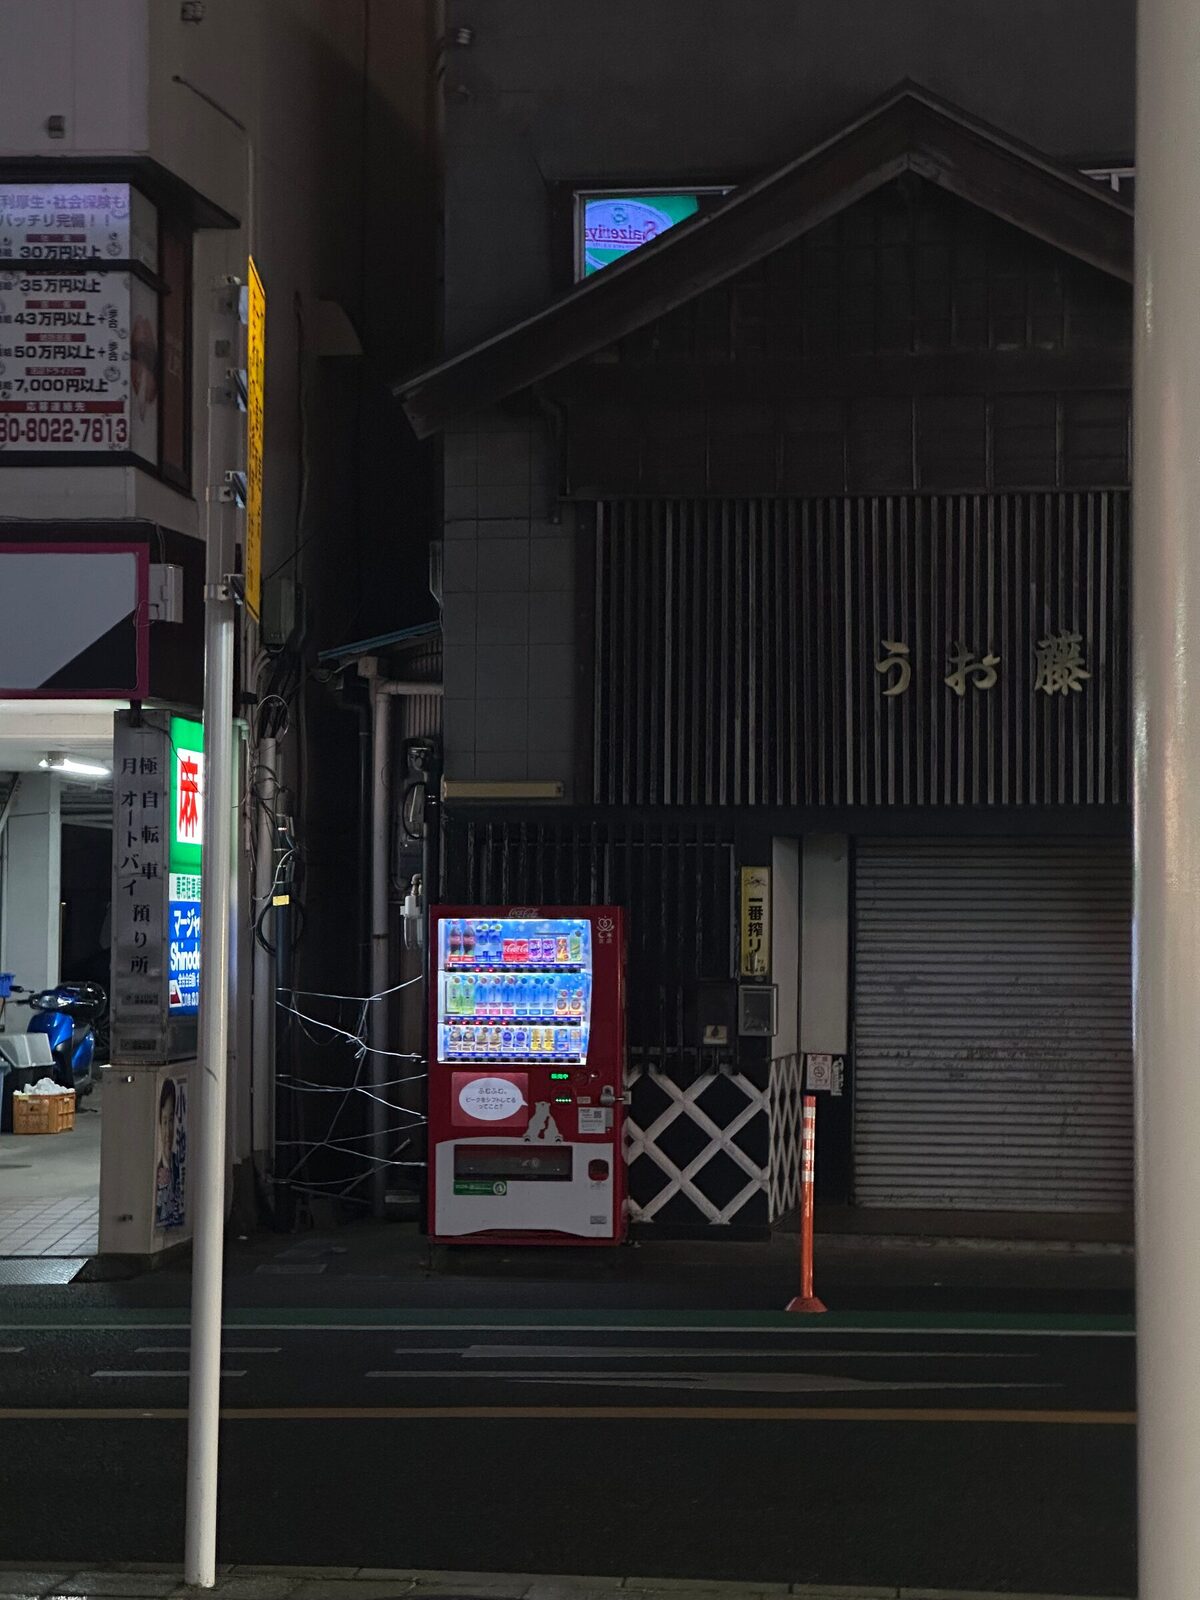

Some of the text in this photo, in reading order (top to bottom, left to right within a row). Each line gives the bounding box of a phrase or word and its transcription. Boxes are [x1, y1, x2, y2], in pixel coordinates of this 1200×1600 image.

[20, 279, 101, 293] 35万円以上
[14, 379, 109, 393] 7,000円以上
[141, 790, 159, 880] 自転車
[748, 898, 763, 952] 一番搾り
[170, 941, 200, 970] Shinod
